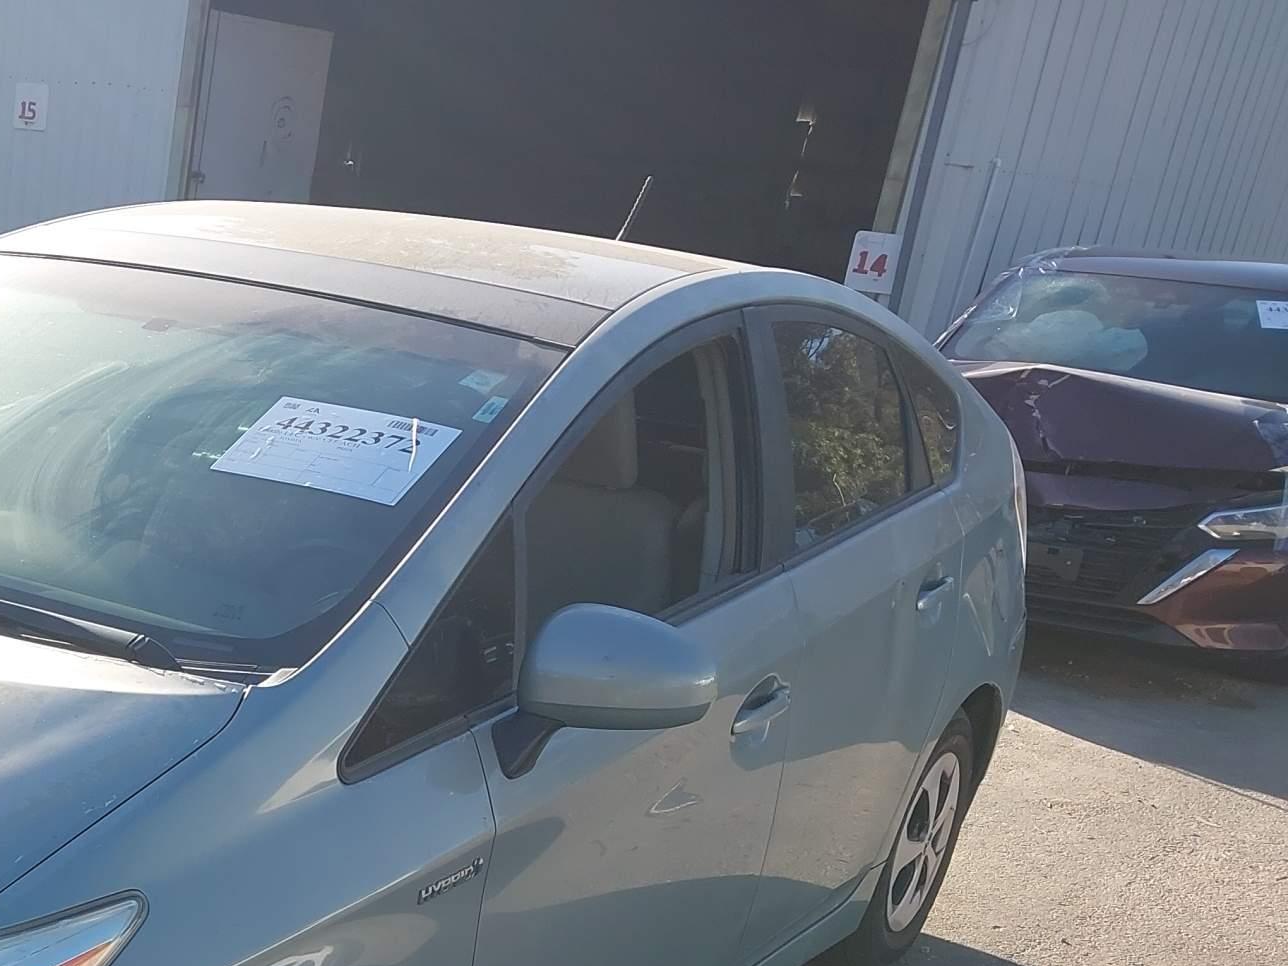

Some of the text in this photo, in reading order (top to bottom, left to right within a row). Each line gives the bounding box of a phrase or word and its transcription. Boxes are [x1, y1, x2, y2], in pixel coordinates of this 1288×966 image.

[18, 101, 36, 120] 15
[852, 251, 889, 277] 14
[277, 416, 420, 454] 44322372
